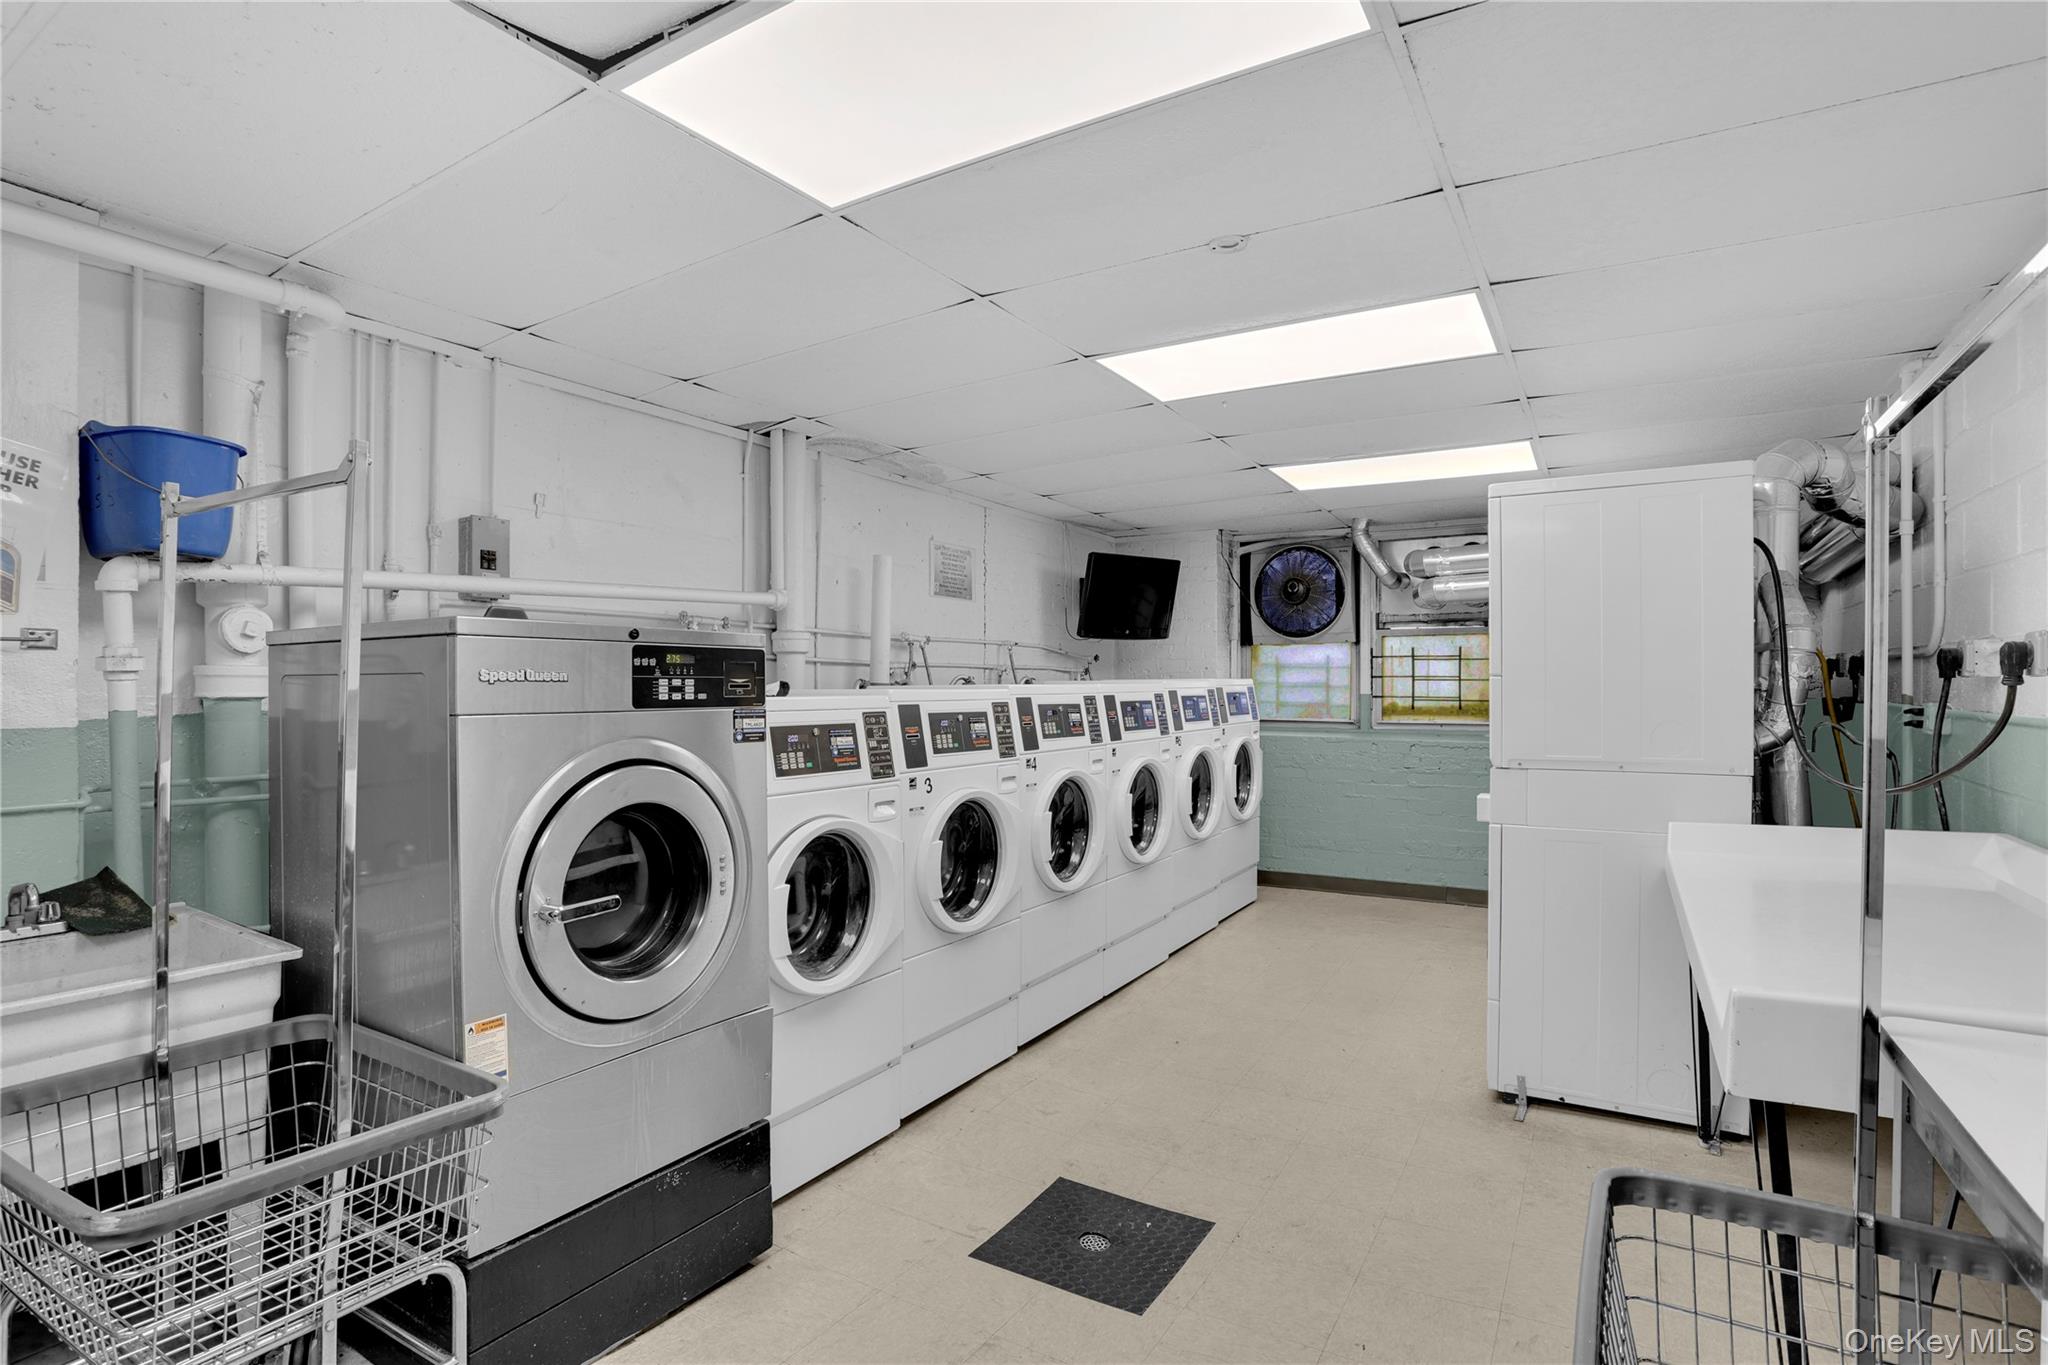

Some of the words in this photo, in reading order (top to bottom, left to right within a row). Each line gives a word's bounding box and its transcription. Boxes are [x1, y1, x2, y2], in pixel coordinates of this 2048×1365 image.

[479, 669, 525, 685] Speed
[526, 669, 569, 683] Queen
[1031, 756, 1038, 772] 4
[924, 777, 933, 794] 3
